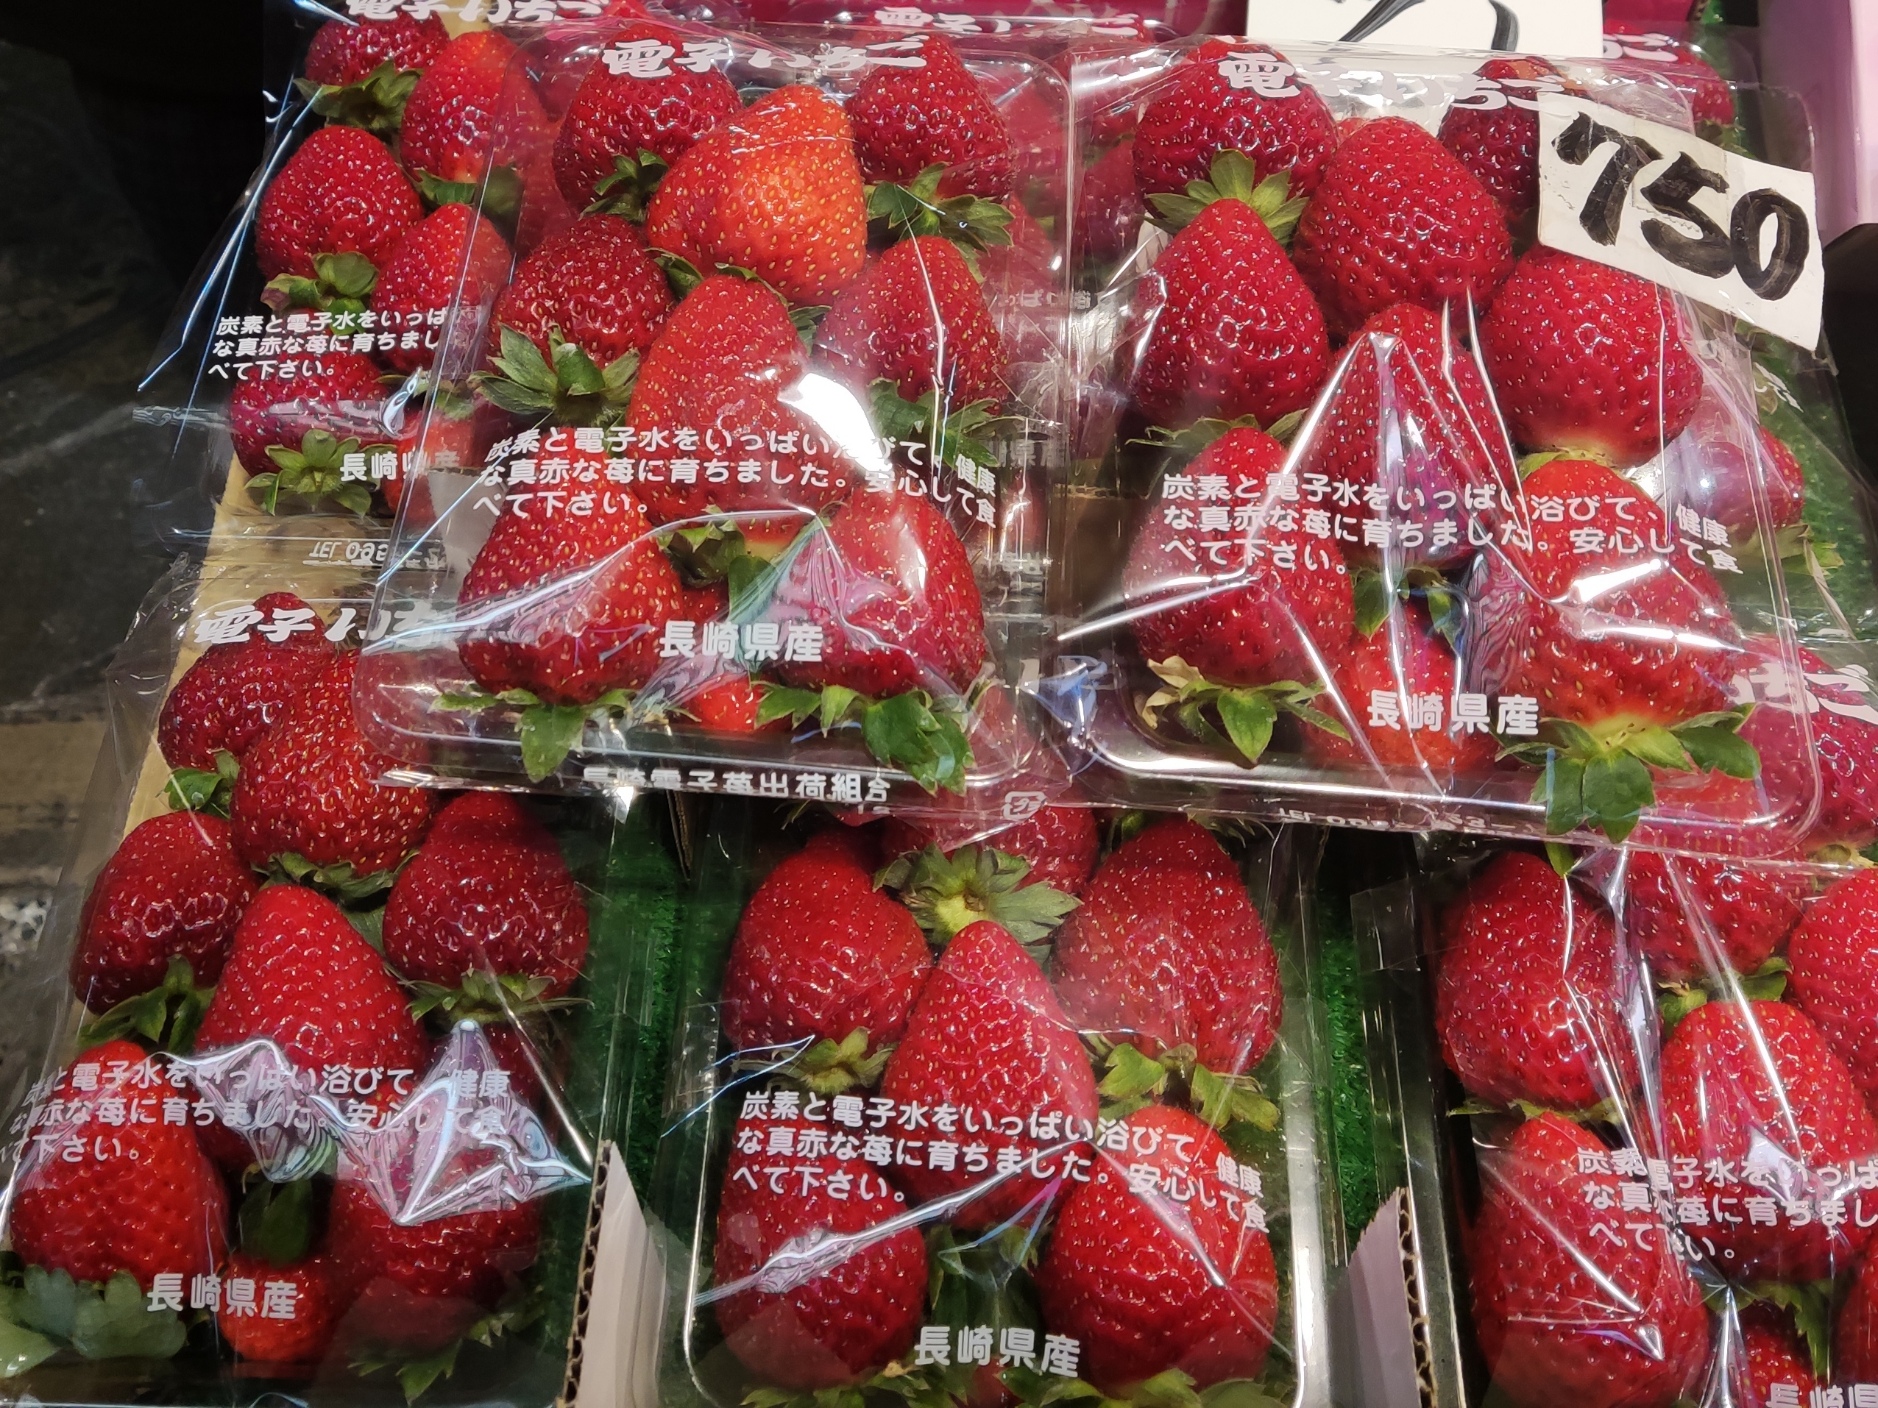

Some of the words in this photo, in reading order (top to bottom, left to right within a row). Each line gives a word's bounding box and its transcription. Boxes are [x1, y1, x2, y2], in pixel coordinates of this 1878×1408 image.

[593, 36, 928, 78] 電子いちご
[1551, 111, 1811, 302] 750
[208, 358, 336, 380] べて下さい。
[472, 490, 648, 519] べて下さい。
[1165, 536, 1347, 577] べて下さい。
[659, 620, 823, 664] 長崎県産
[1367, 689, 1540, 737] 長崎県産
[740, 1090, 1263, 1198] 炭素と電子水をいっぱい浴びて健康
[733, 1163, 906, 1203] べて下さい。
[147, 1273, 297, 1319] 長崎県産
[914, 1325, 1081, 1378] 長崎県産
